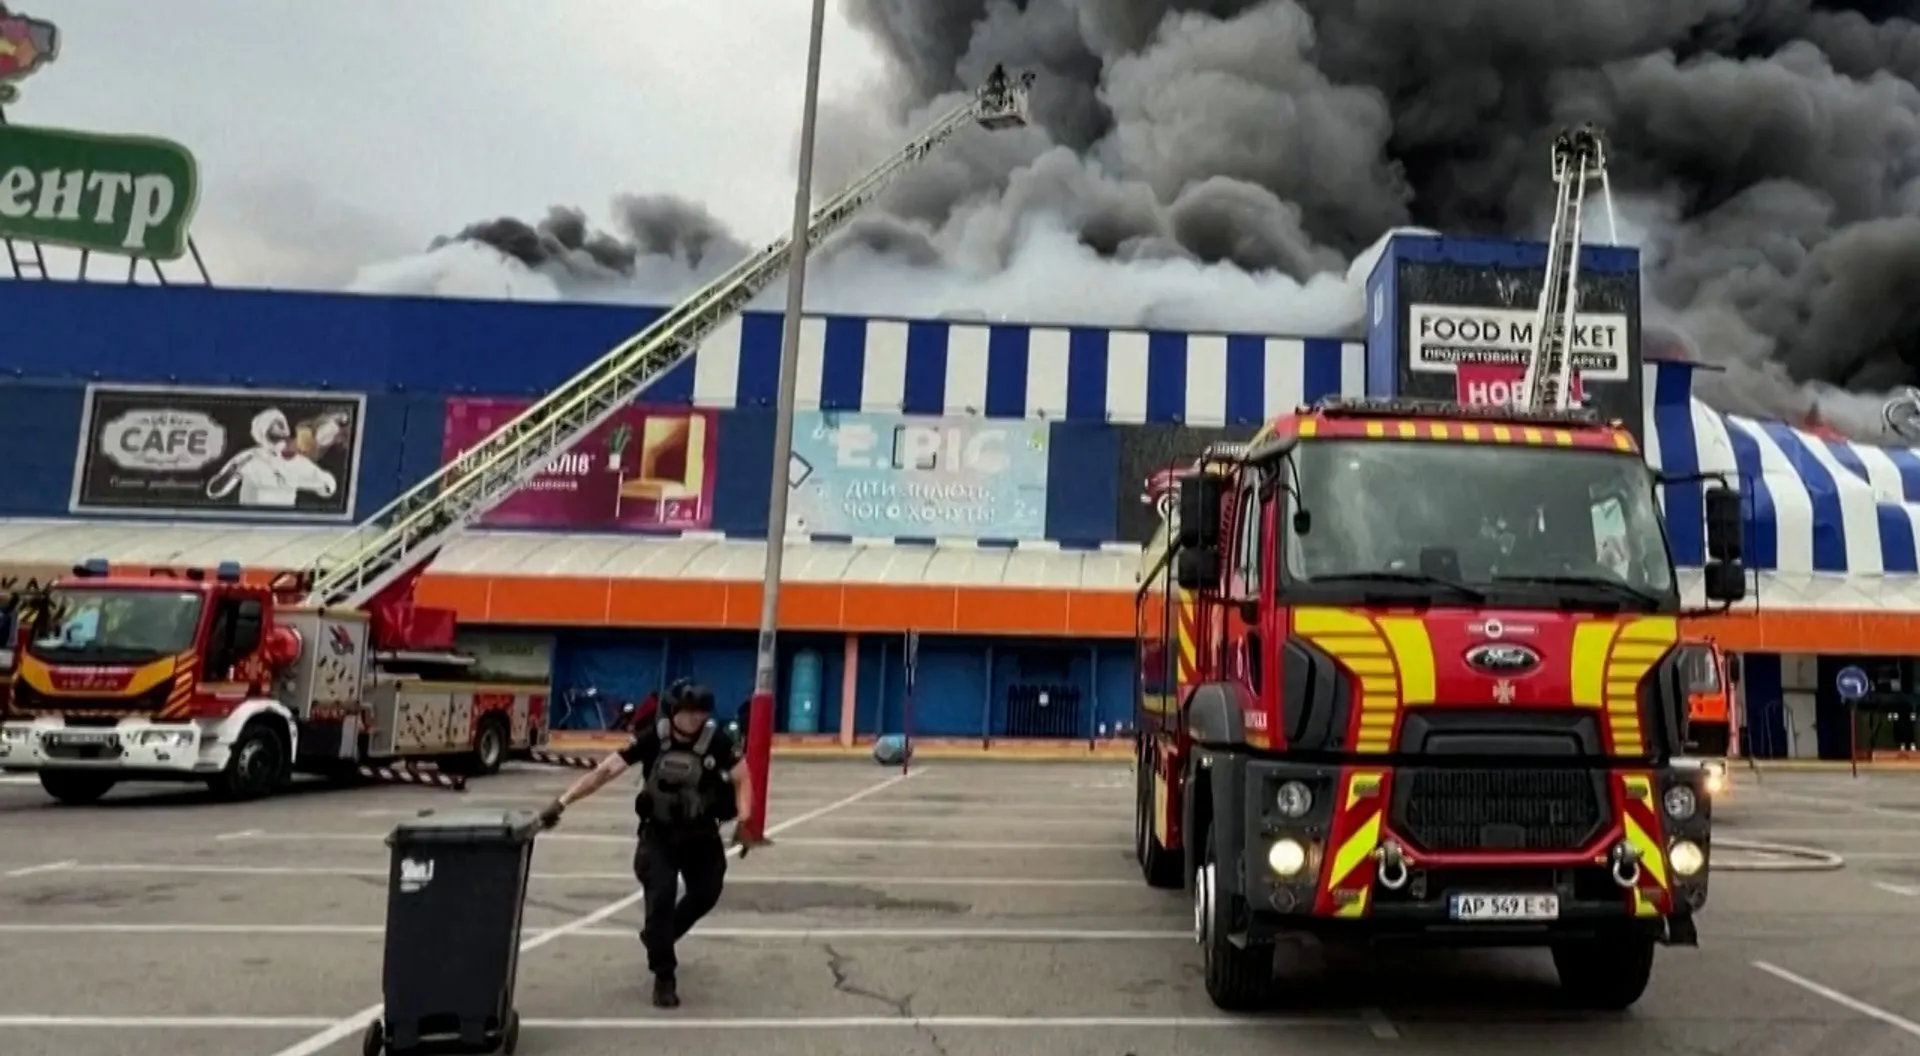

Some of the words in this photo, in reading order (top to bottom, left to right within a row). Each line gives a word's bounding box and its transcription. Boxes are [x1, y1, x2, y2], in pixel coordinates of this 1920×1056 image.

[0, 166, 174, 248] ентр
[1420, 316, 1501, 342] FOOD
[1510, 322, 1617, 347] MKET
[120, 427, 209, 455] CAFE
[843, 501, 900, 520] ЧОГО
